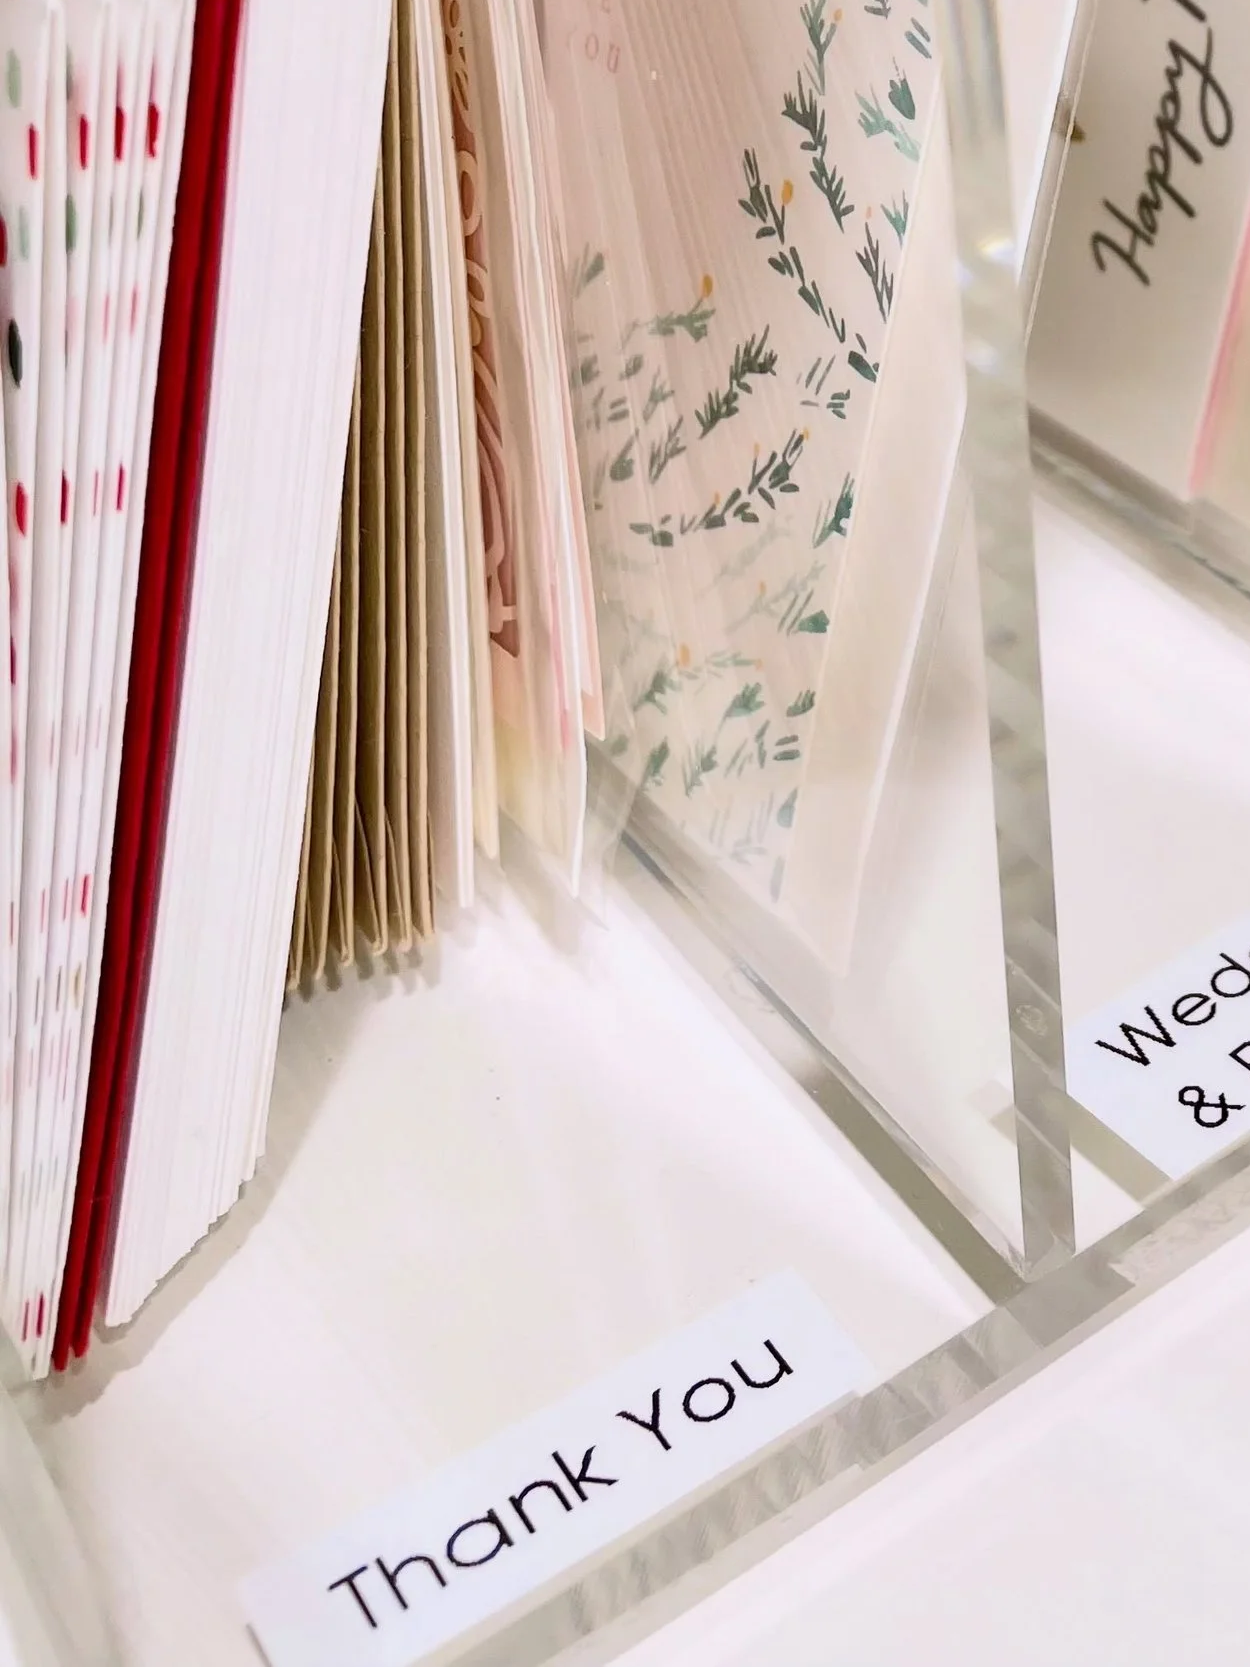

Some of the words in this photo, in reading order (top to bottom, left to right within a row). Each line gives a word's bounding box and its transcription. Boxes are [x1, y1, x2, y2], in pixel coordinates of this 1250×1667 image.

[1092, 29, 1233, 285] Happy
[1177, 1085, 1246, 1129] &
[327, 1444, 619, 1628] Thank
[615, 1339, 794, 1451] You
